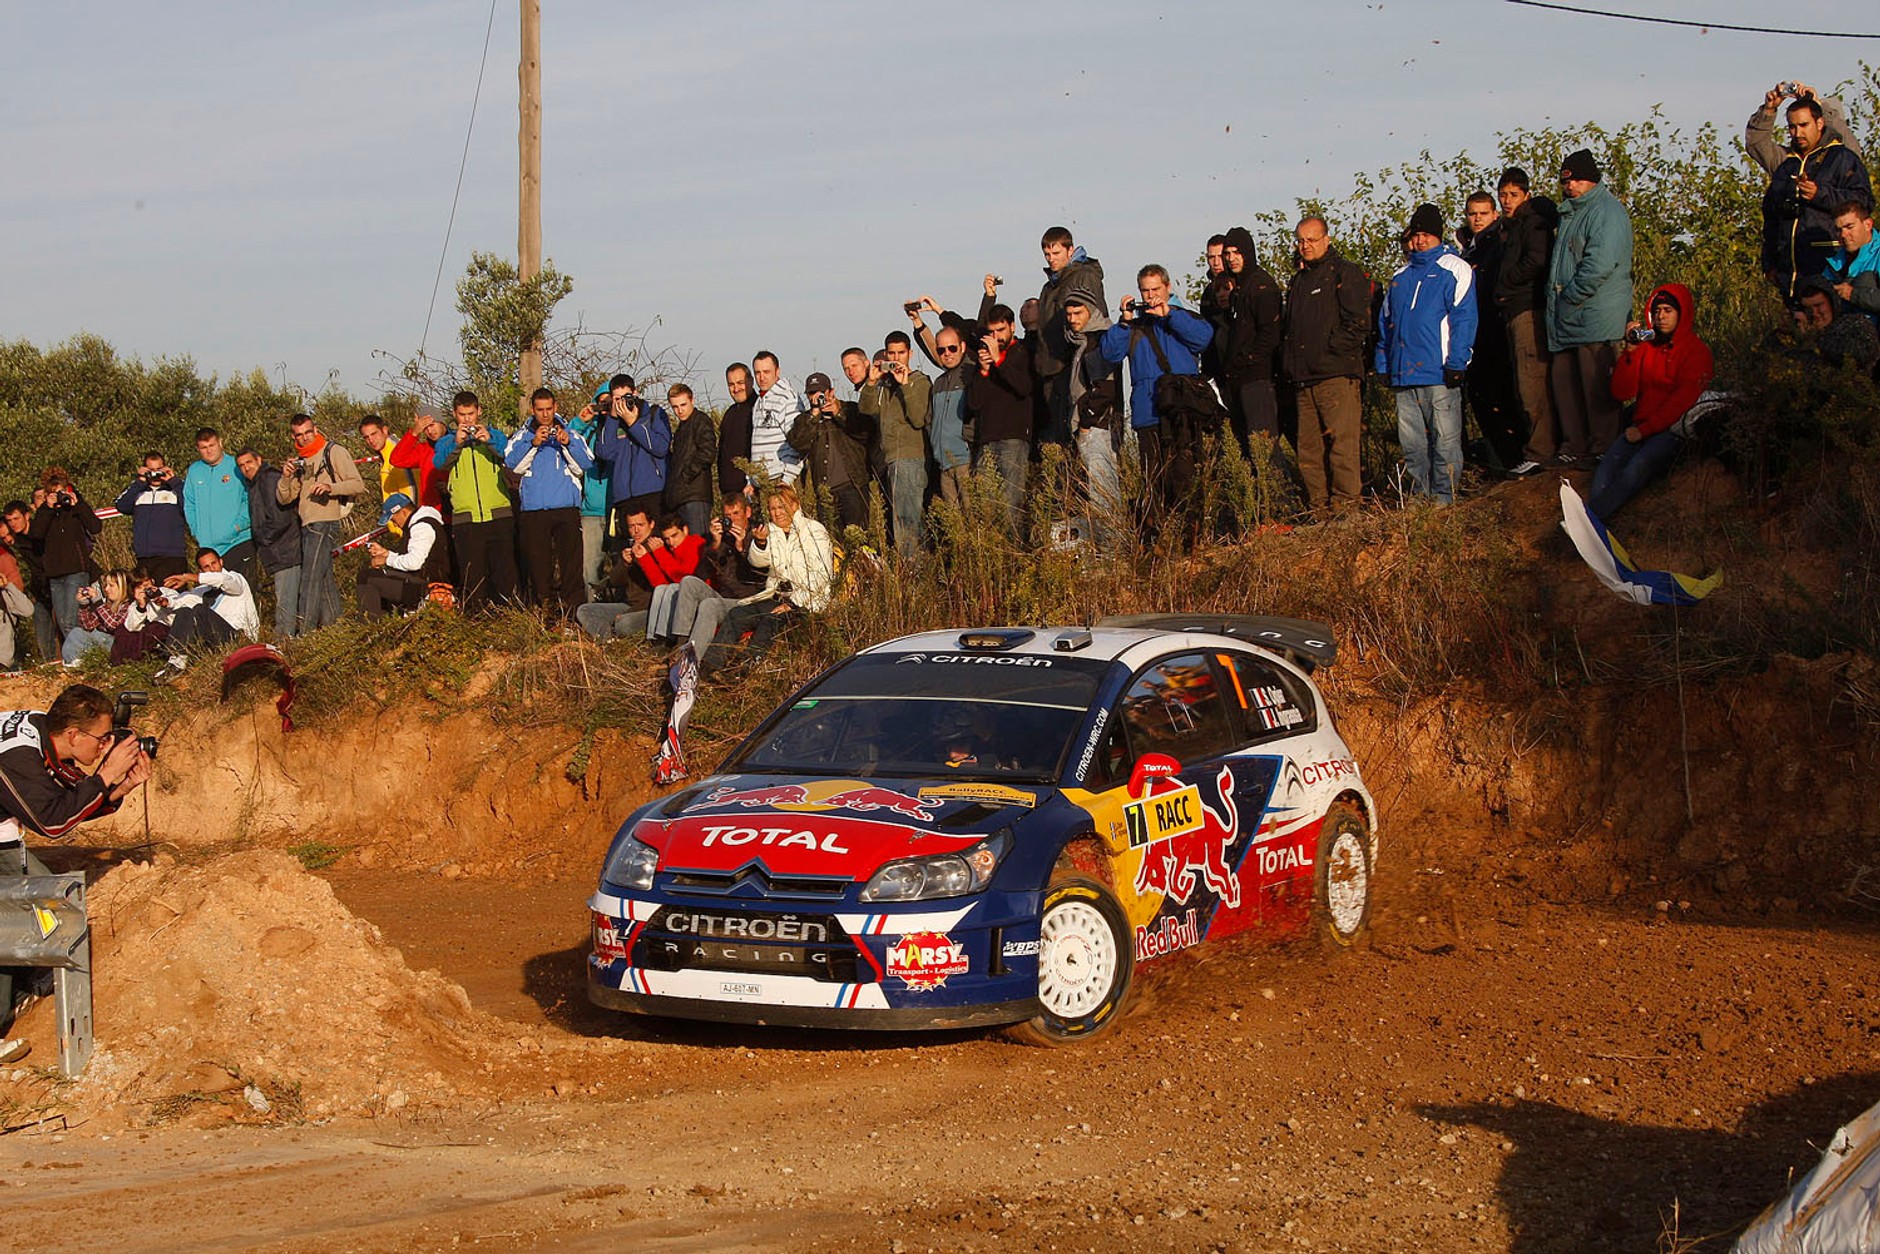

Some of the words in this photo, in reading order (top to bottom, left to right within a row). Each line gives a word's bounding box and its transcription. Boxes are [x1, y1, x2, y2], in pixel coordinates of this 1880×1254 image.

[1143, 764, 1171, 772] TOTAL
[1302, 759, 1355, 785] CITRO
[1155, 795, 1193, 832] RACC
[701, 825, 849, 855] TOTAL
[1256, 844, 1313, 876] TOTAL
[1135, 916, 1168, 961] Red
[1167, 908, 1199, 952] Bull
[665, 942, 828, 963] RACING
[888, 943, 964, 970] MARSY
[889, 967, 929, 976] Transport
